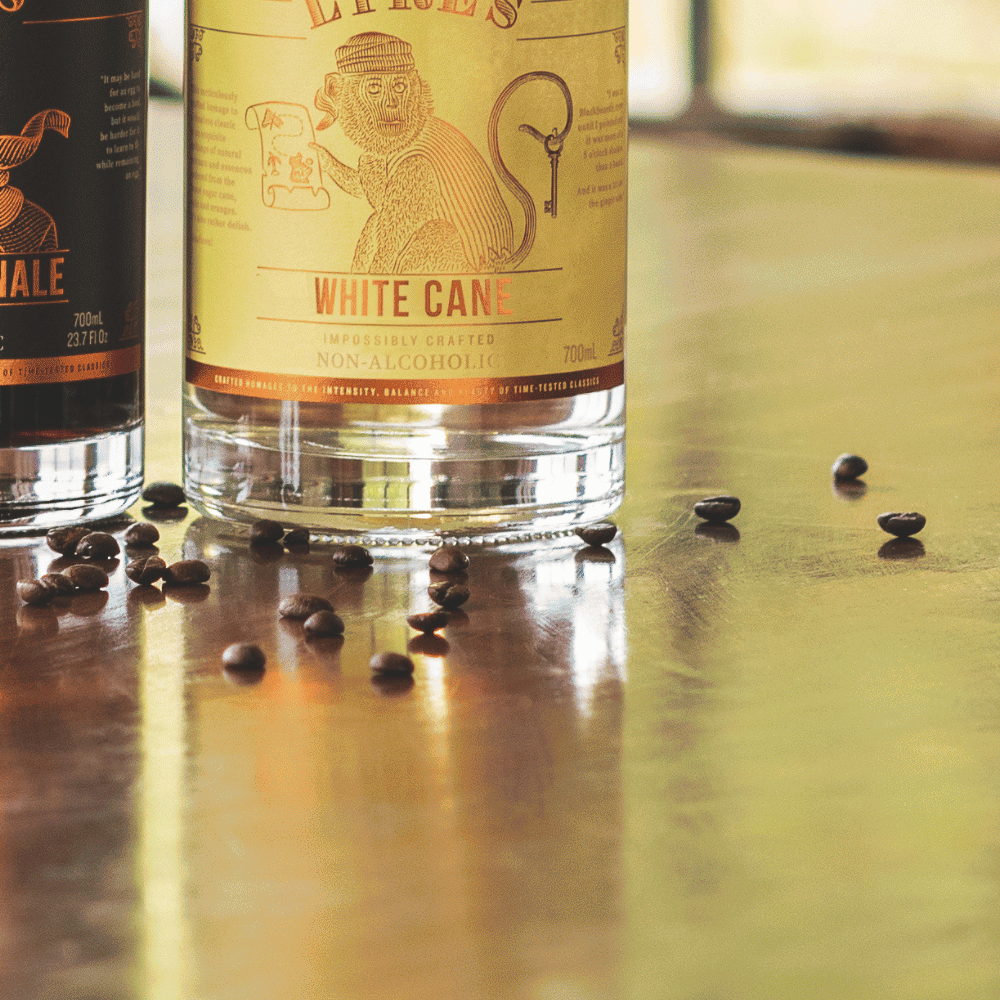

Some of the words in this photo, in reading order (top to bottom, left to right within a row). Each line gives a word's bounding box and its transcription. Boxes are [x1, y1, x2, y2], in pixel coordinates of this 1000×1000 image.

[314, 276, 409, 318] WHITE
[424, 277, 514, 318] CANE
[74, 311, 103, 327] 700mL
[67, 330, 87, 347] 23.7
[323, 333, 417, 347] IMPOSSIBLY
[426, 333, 494, 346] CRAFTED
[317, 352, 499, 370] NON-ALCOHOLIC
[563, 342, 597, 363] 700mL
[3, 368, 13, 377] OF
[214, 374, 243, 387] CRAFTED
[323, 385, 380, 398] INTENSITY,
[383, 387, 429, 398] BALANCE
[513, 380, 567, 394] TIME-TESTED
[569, 376, 600, 390] CLASSICS
